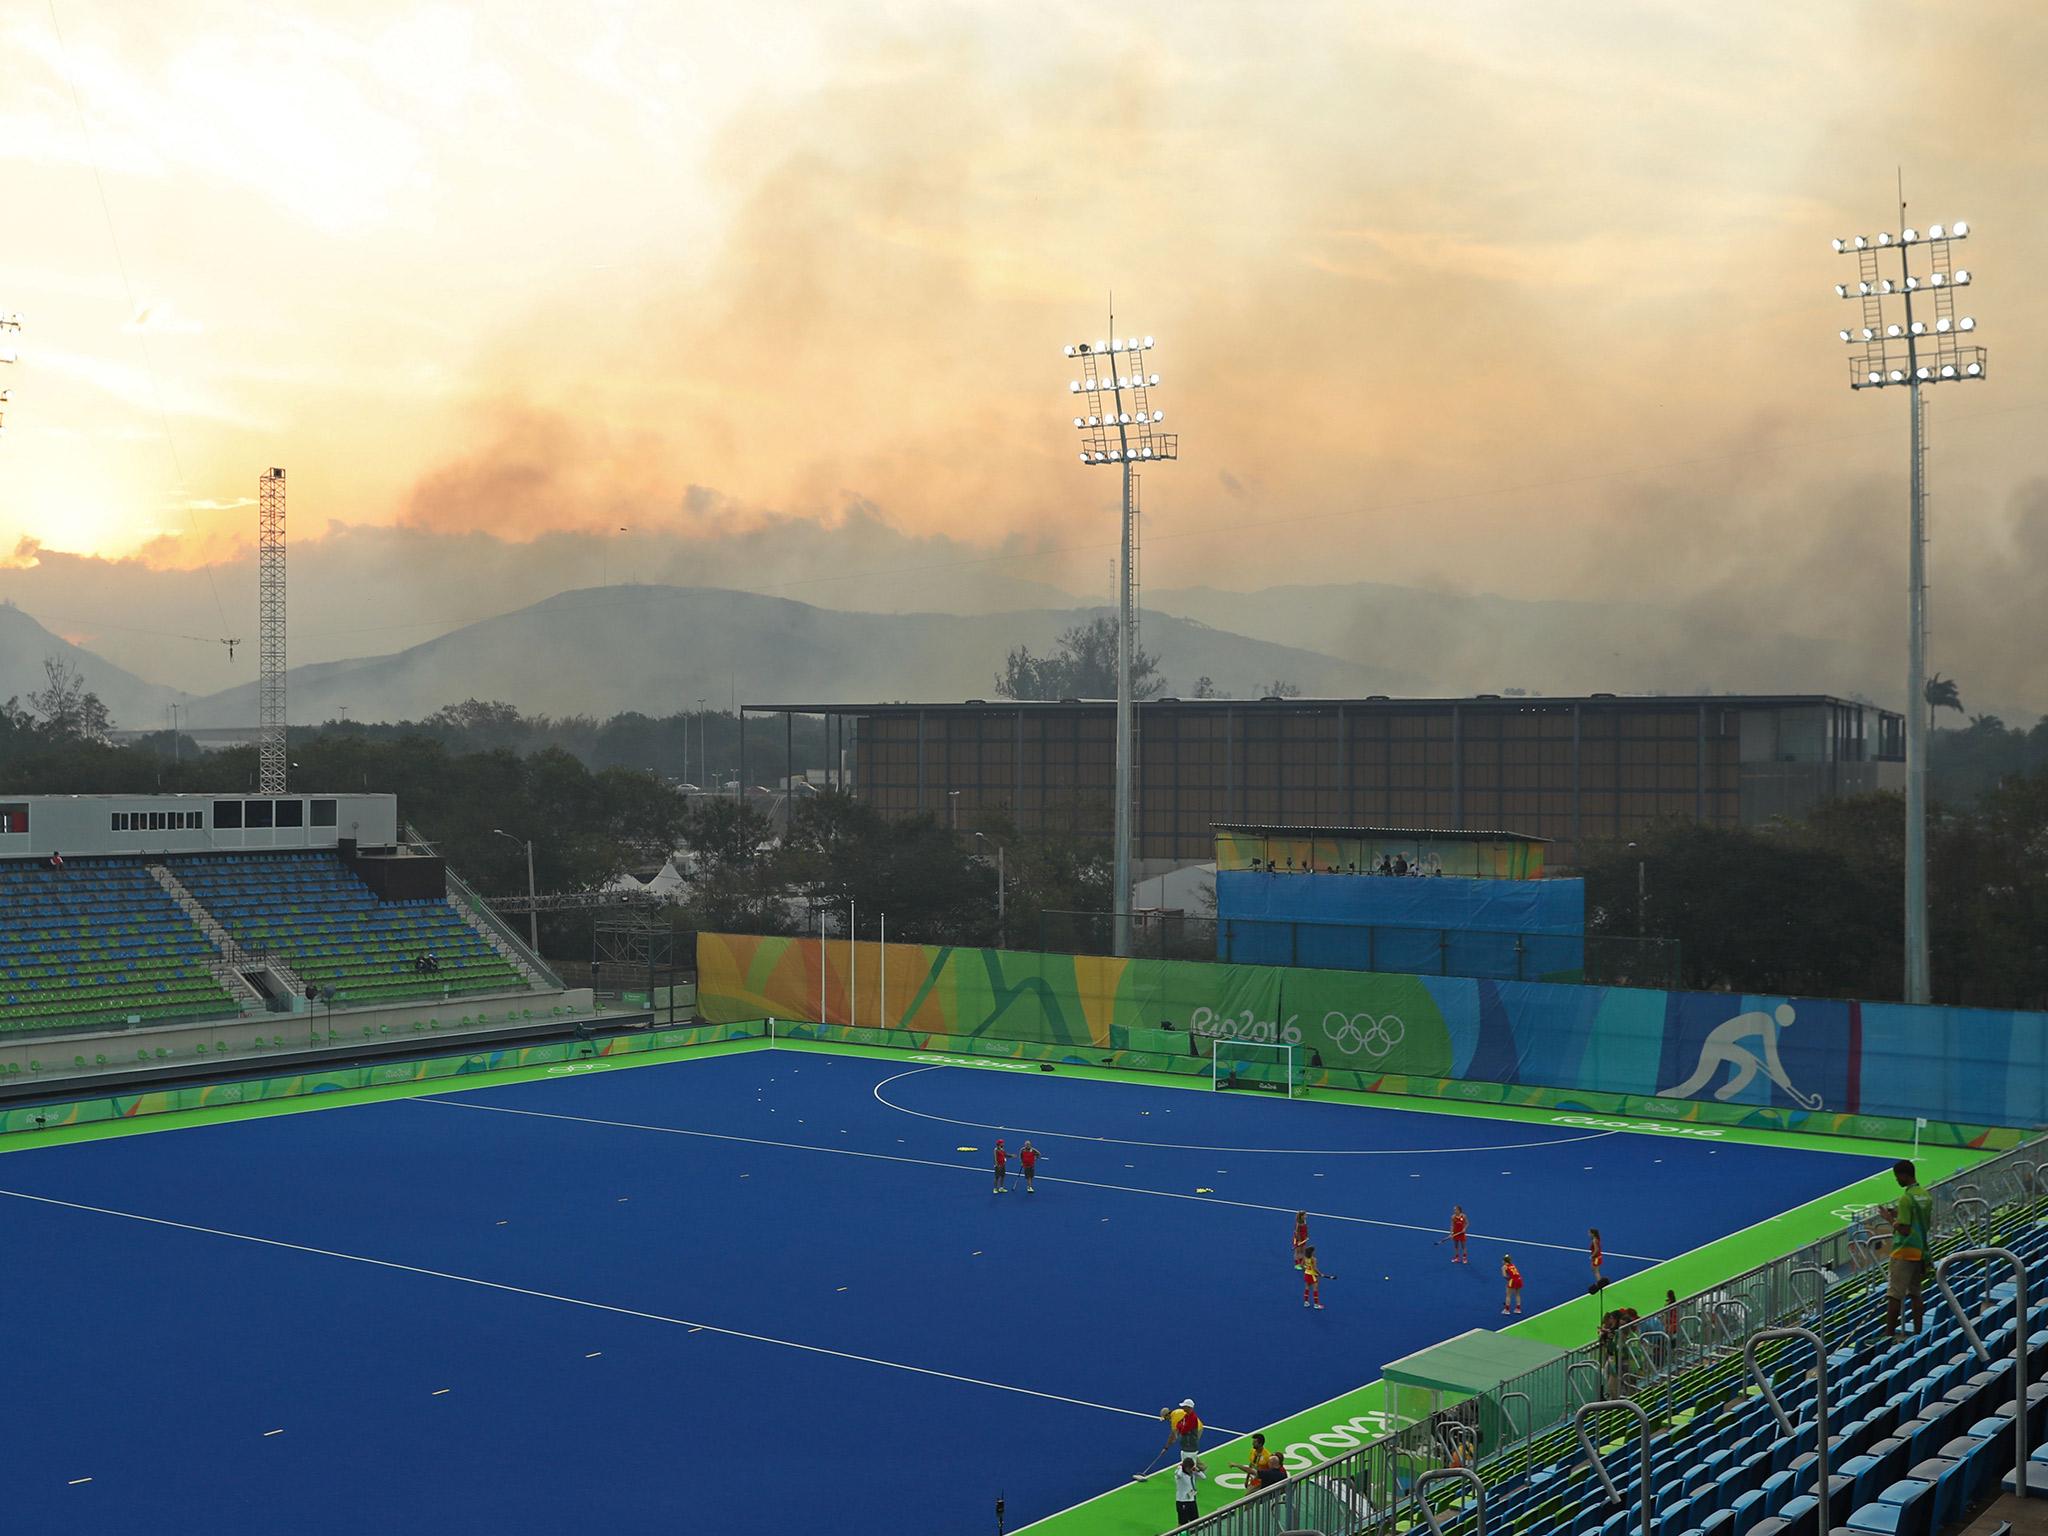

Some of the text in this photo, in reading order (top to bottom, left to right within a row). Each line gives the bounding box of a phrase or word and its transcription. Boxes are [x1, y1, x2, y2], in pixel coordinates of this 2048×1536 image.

[1190, 1007, 1302, 1045] Rio2016
[1643, 1102, 1680, 1115] Rio2016
[1551, 1116, 1727, 1137] Rio2016
